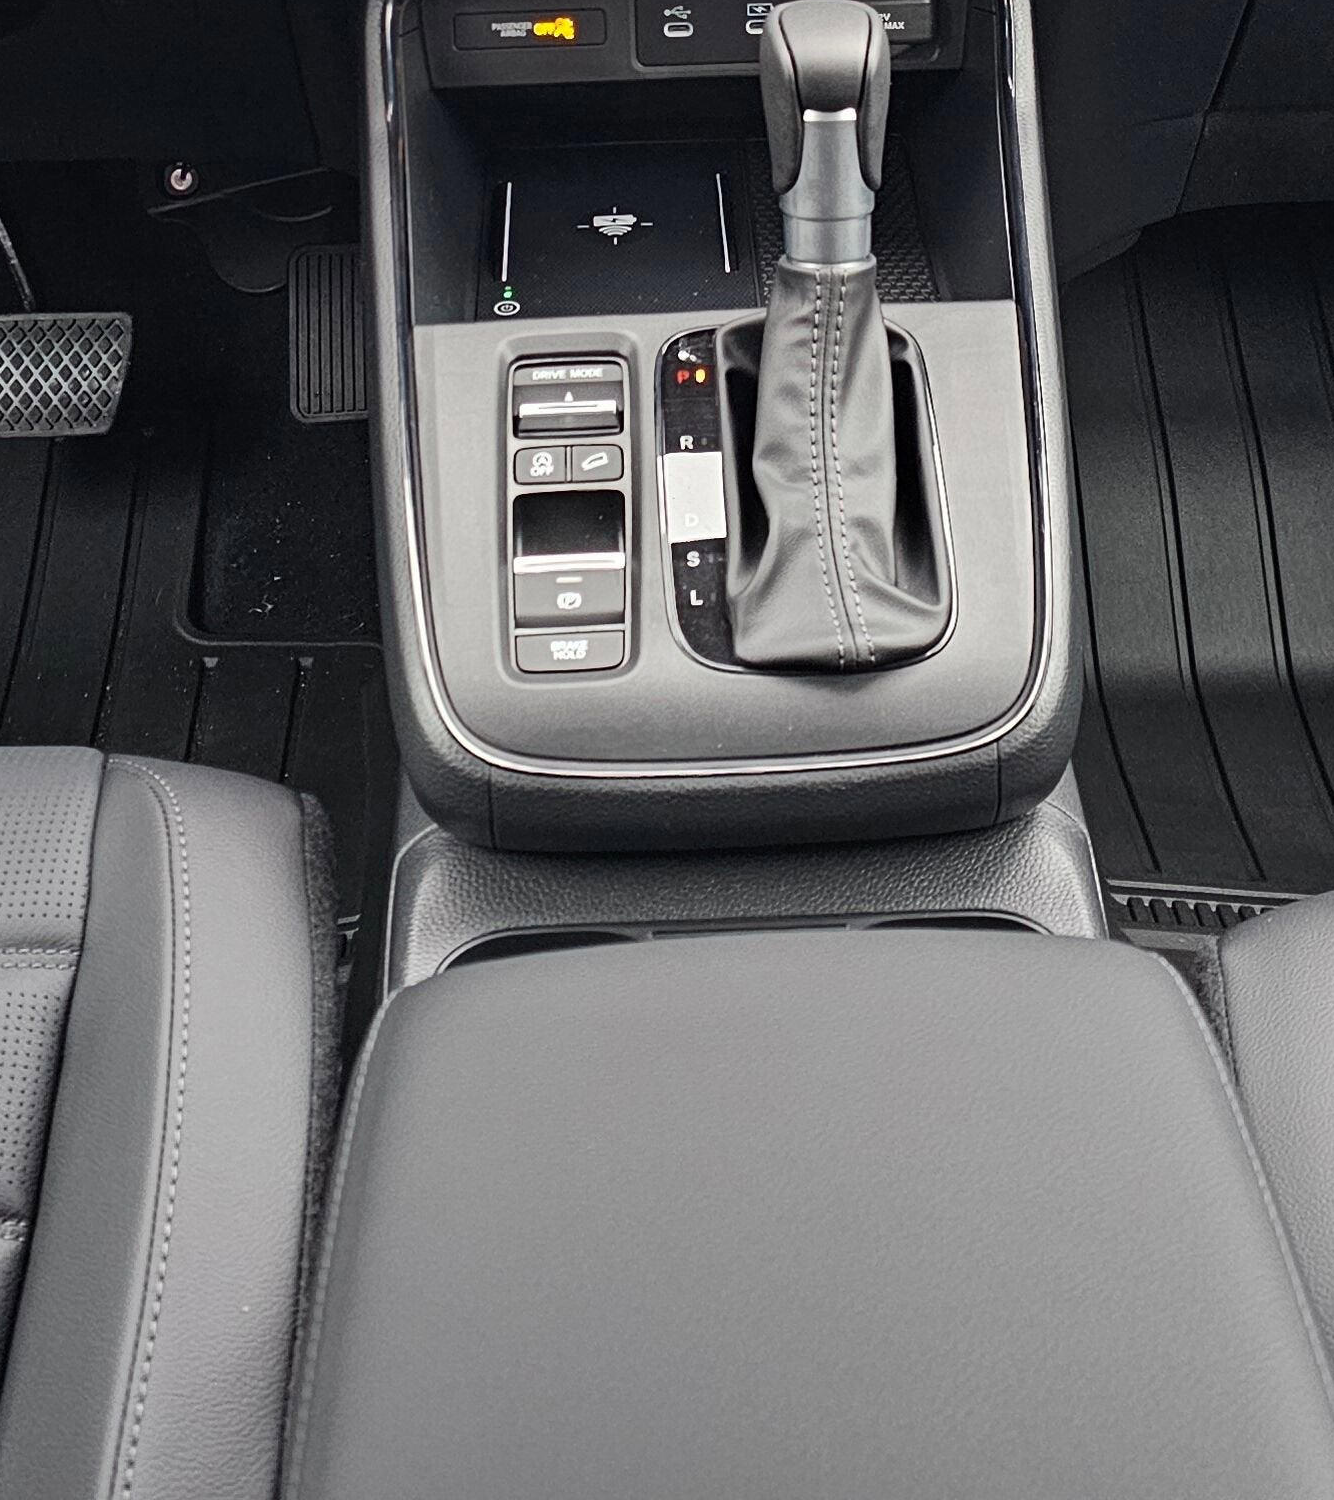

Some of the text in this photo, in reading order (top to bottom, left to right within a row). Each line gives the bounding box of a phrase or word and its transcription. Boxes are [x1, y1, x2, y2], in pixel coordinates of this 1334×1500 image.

[884, 22, 905, 30] MAX
[532, 367, 603, 381] DRIVE MODE
[677, 370, 690, 384] P
[680, 435, 693, 450] R
[530, 464, 554, 477] OFF
[685, 513, 699, 528] D
[686, 551, 700, 567] S
[690, 589, 704, 606] L
[553, 649, 587, 660] HOLD
